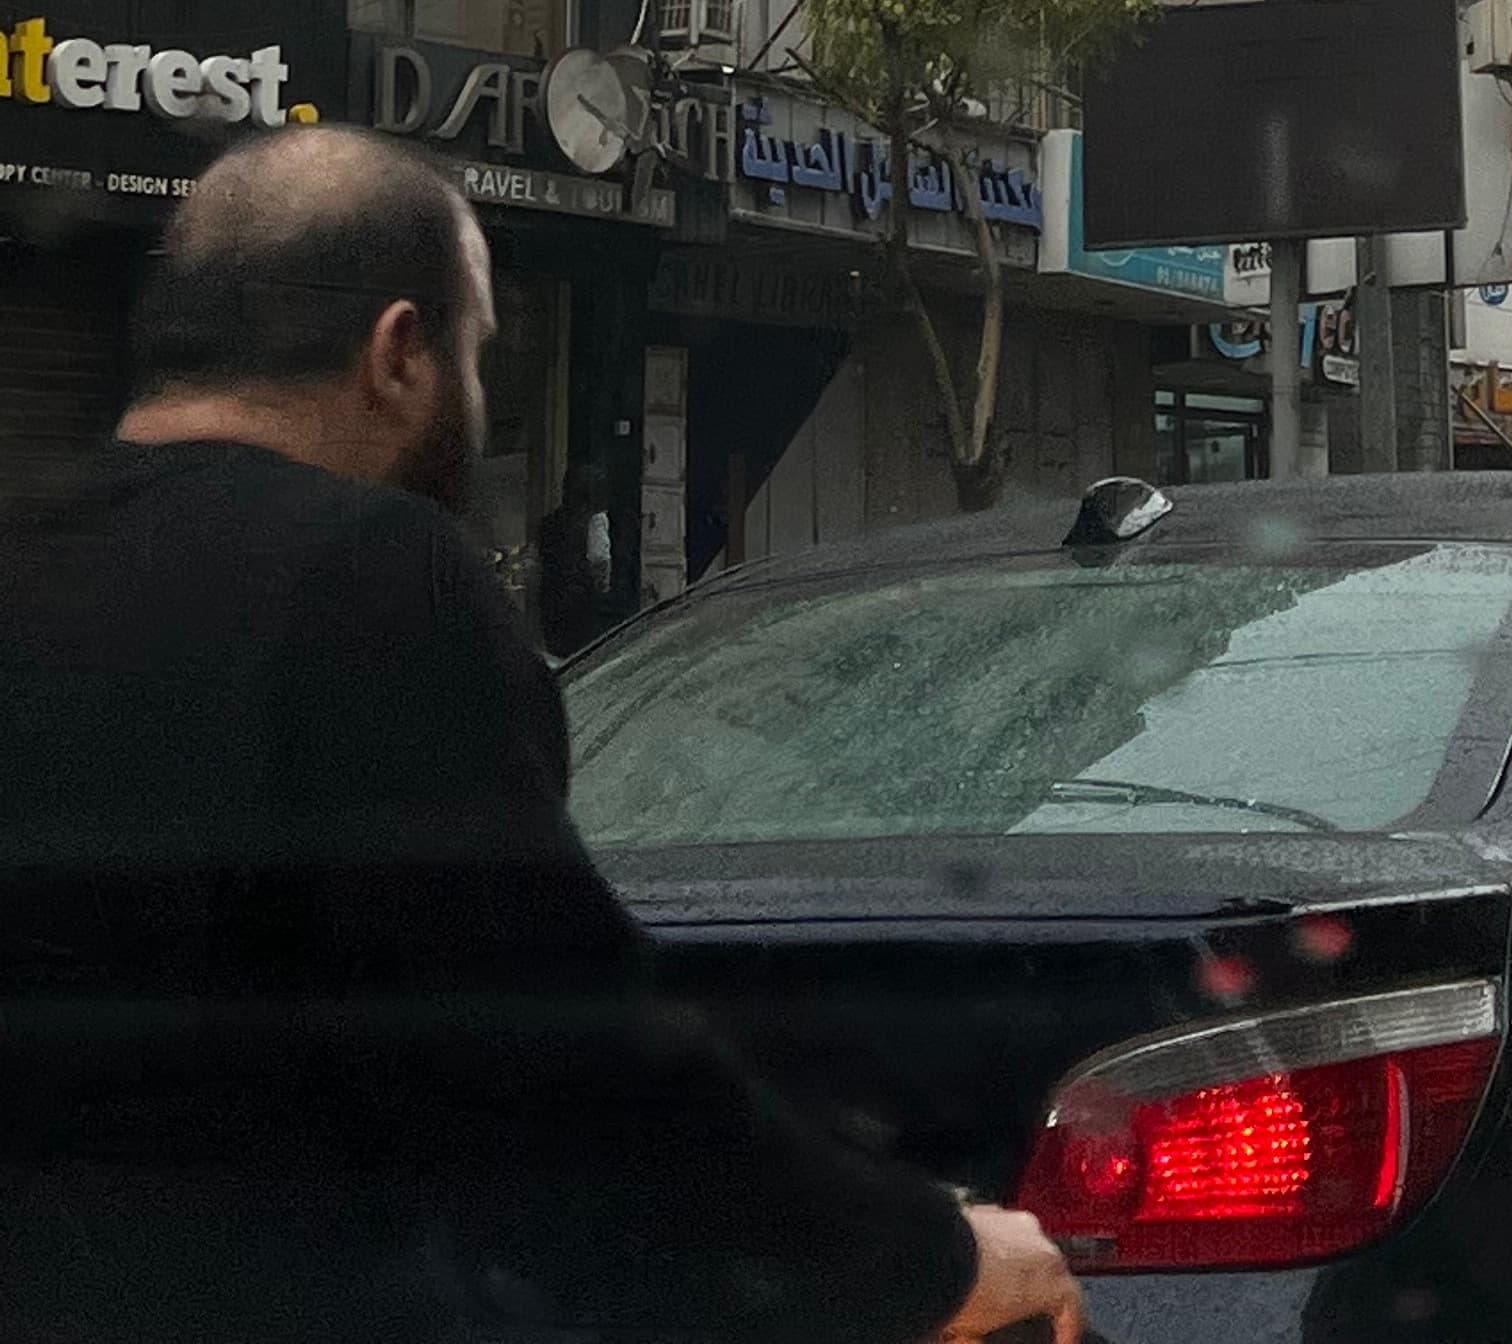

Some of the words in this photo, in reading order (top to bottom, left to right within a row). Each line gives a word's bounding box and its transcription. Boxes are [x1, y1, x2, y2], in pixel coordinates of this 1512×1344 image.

[0, 16, 319, 127] terest.
[107, 173, 168, 195] DESIGN
[463, 167, 537, 202] RAVEL
